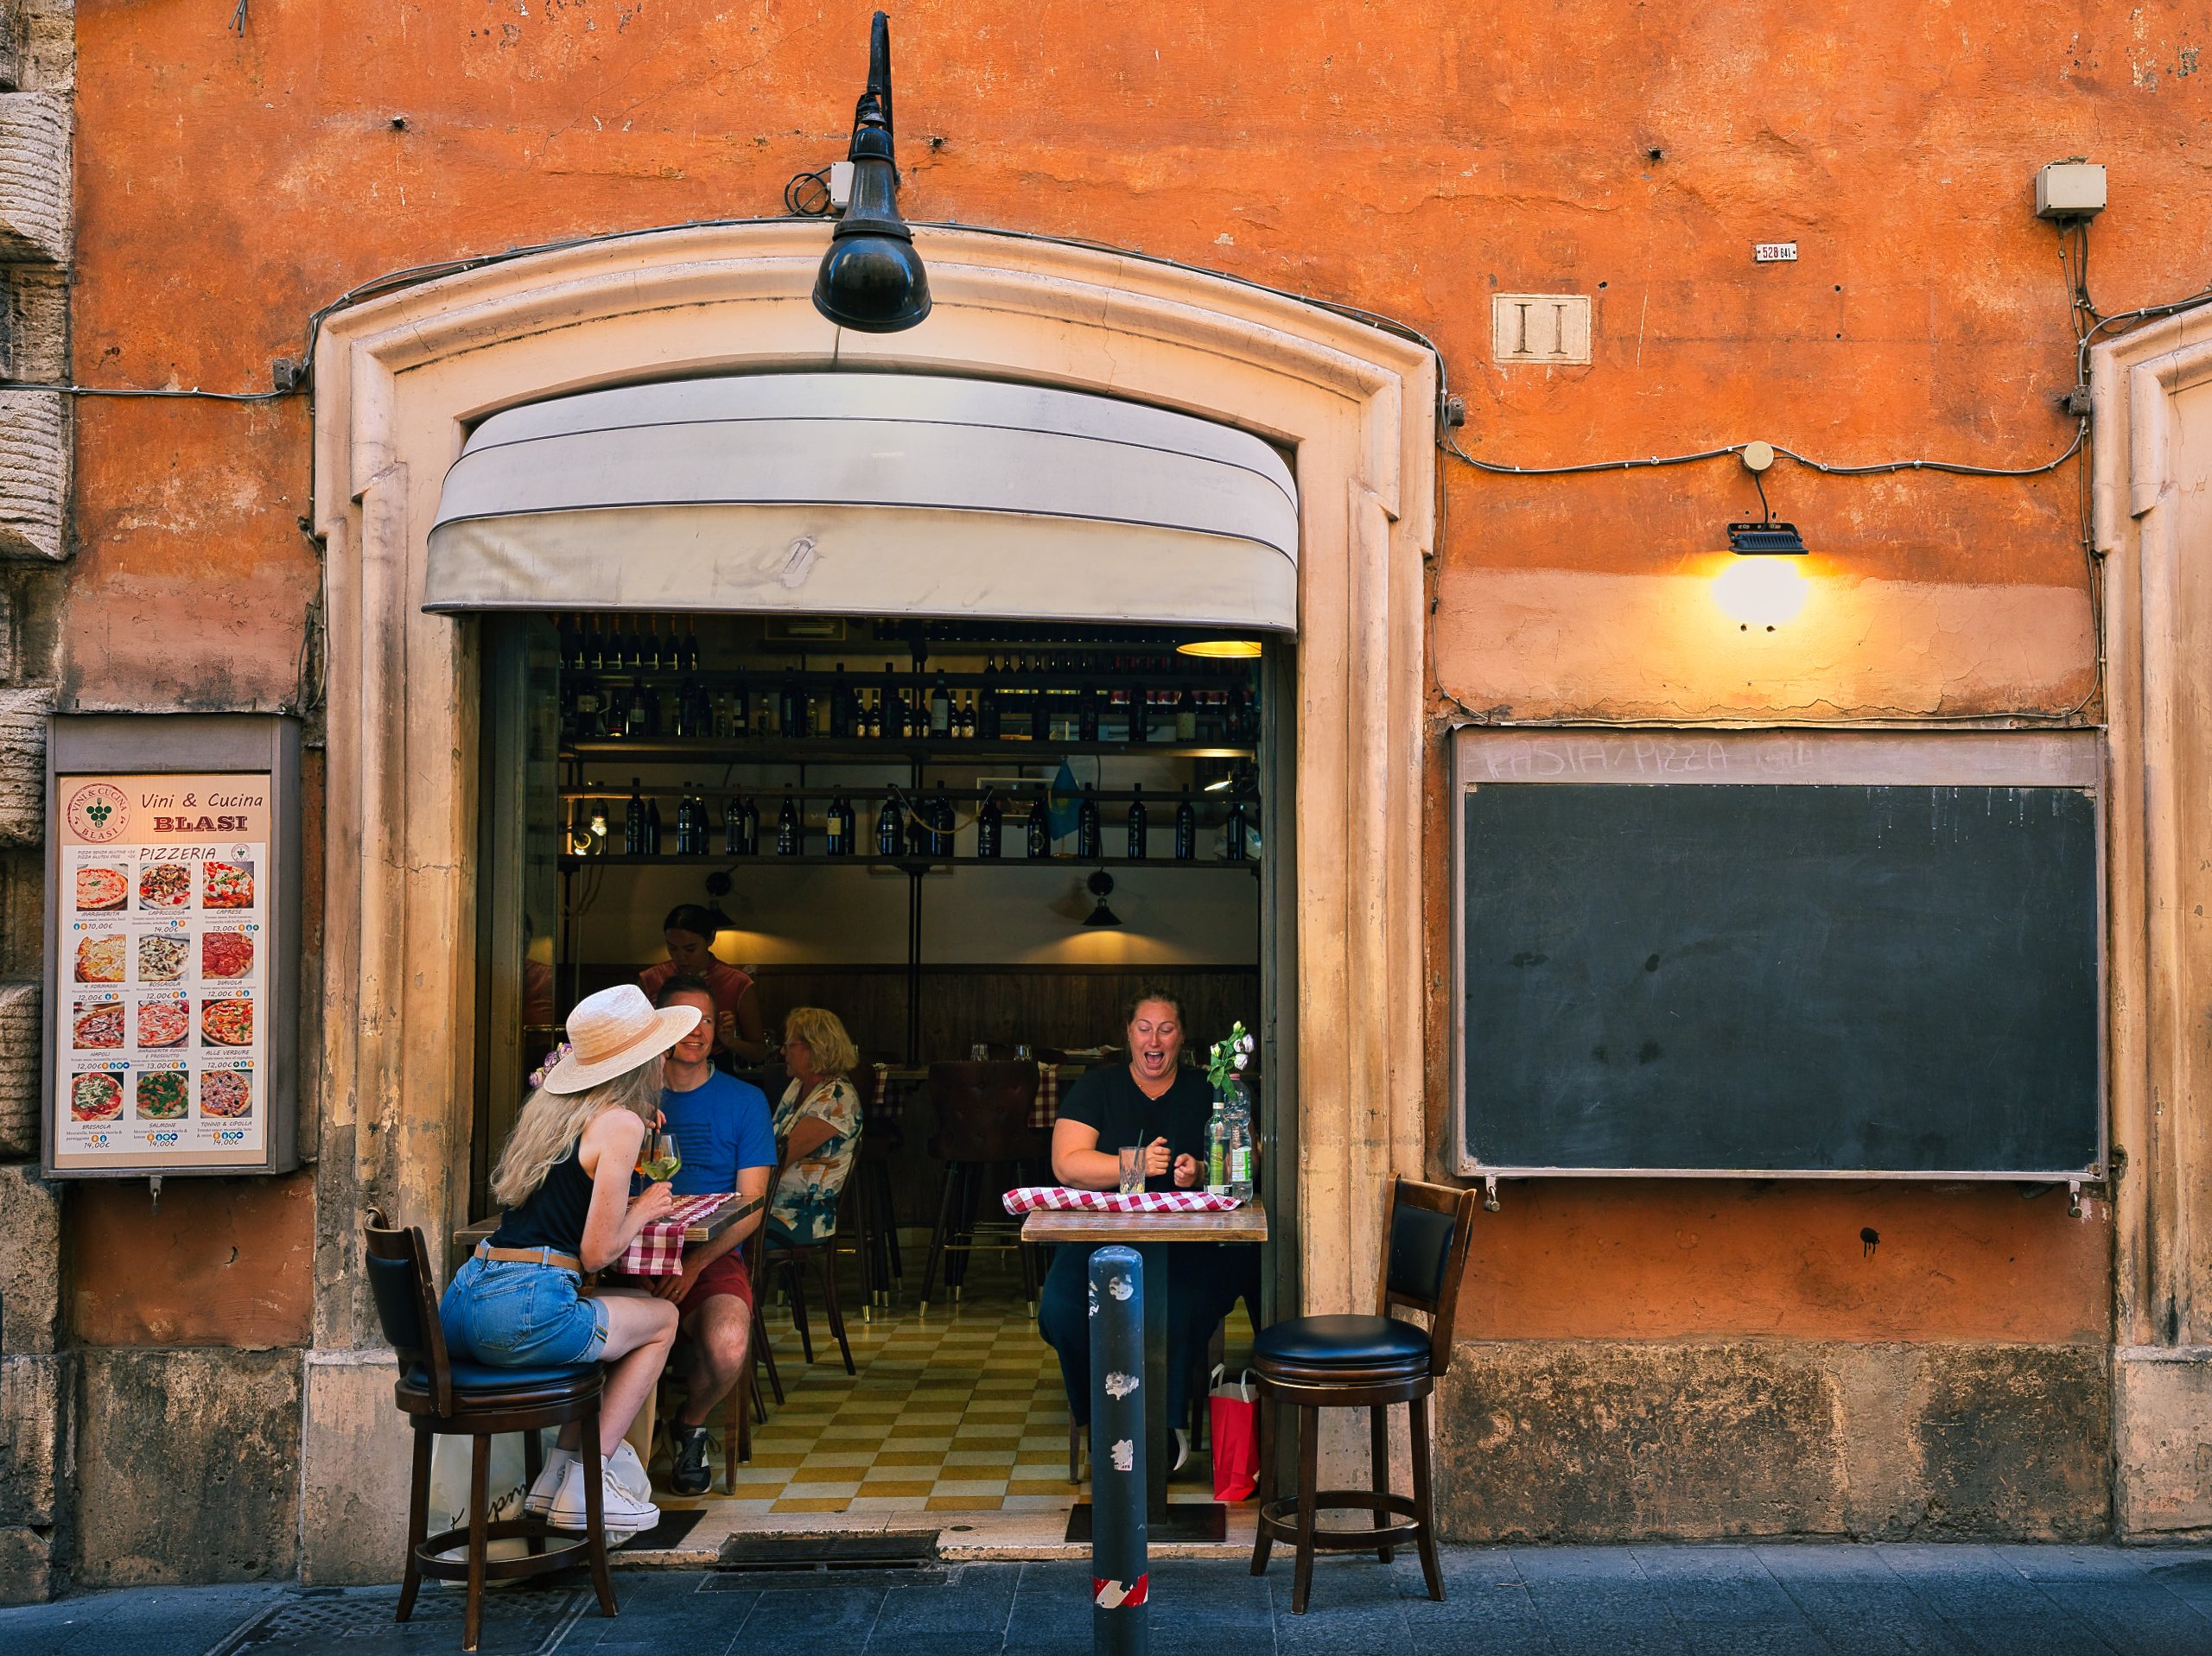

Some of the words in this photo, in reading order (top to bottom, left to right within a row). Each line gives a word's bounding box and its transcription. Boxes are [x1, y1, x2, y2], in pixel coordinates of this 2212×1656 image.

[1763, 246, 1779, 258] 528
[1780, 247, 1791, 258] 641
[73, 793, 87, 812] VINI
[98, 787, 127, 811] CUCINA
[142, 793, 175, 809] Vini
[182, 792, 197, 808] &
[207, 792, 263, 808] Cucina
[153, 815, 248, 833] BLASI
[81, 828, 118, 840] BLASI
[139, 847, 216, 861] PIZZERIA
